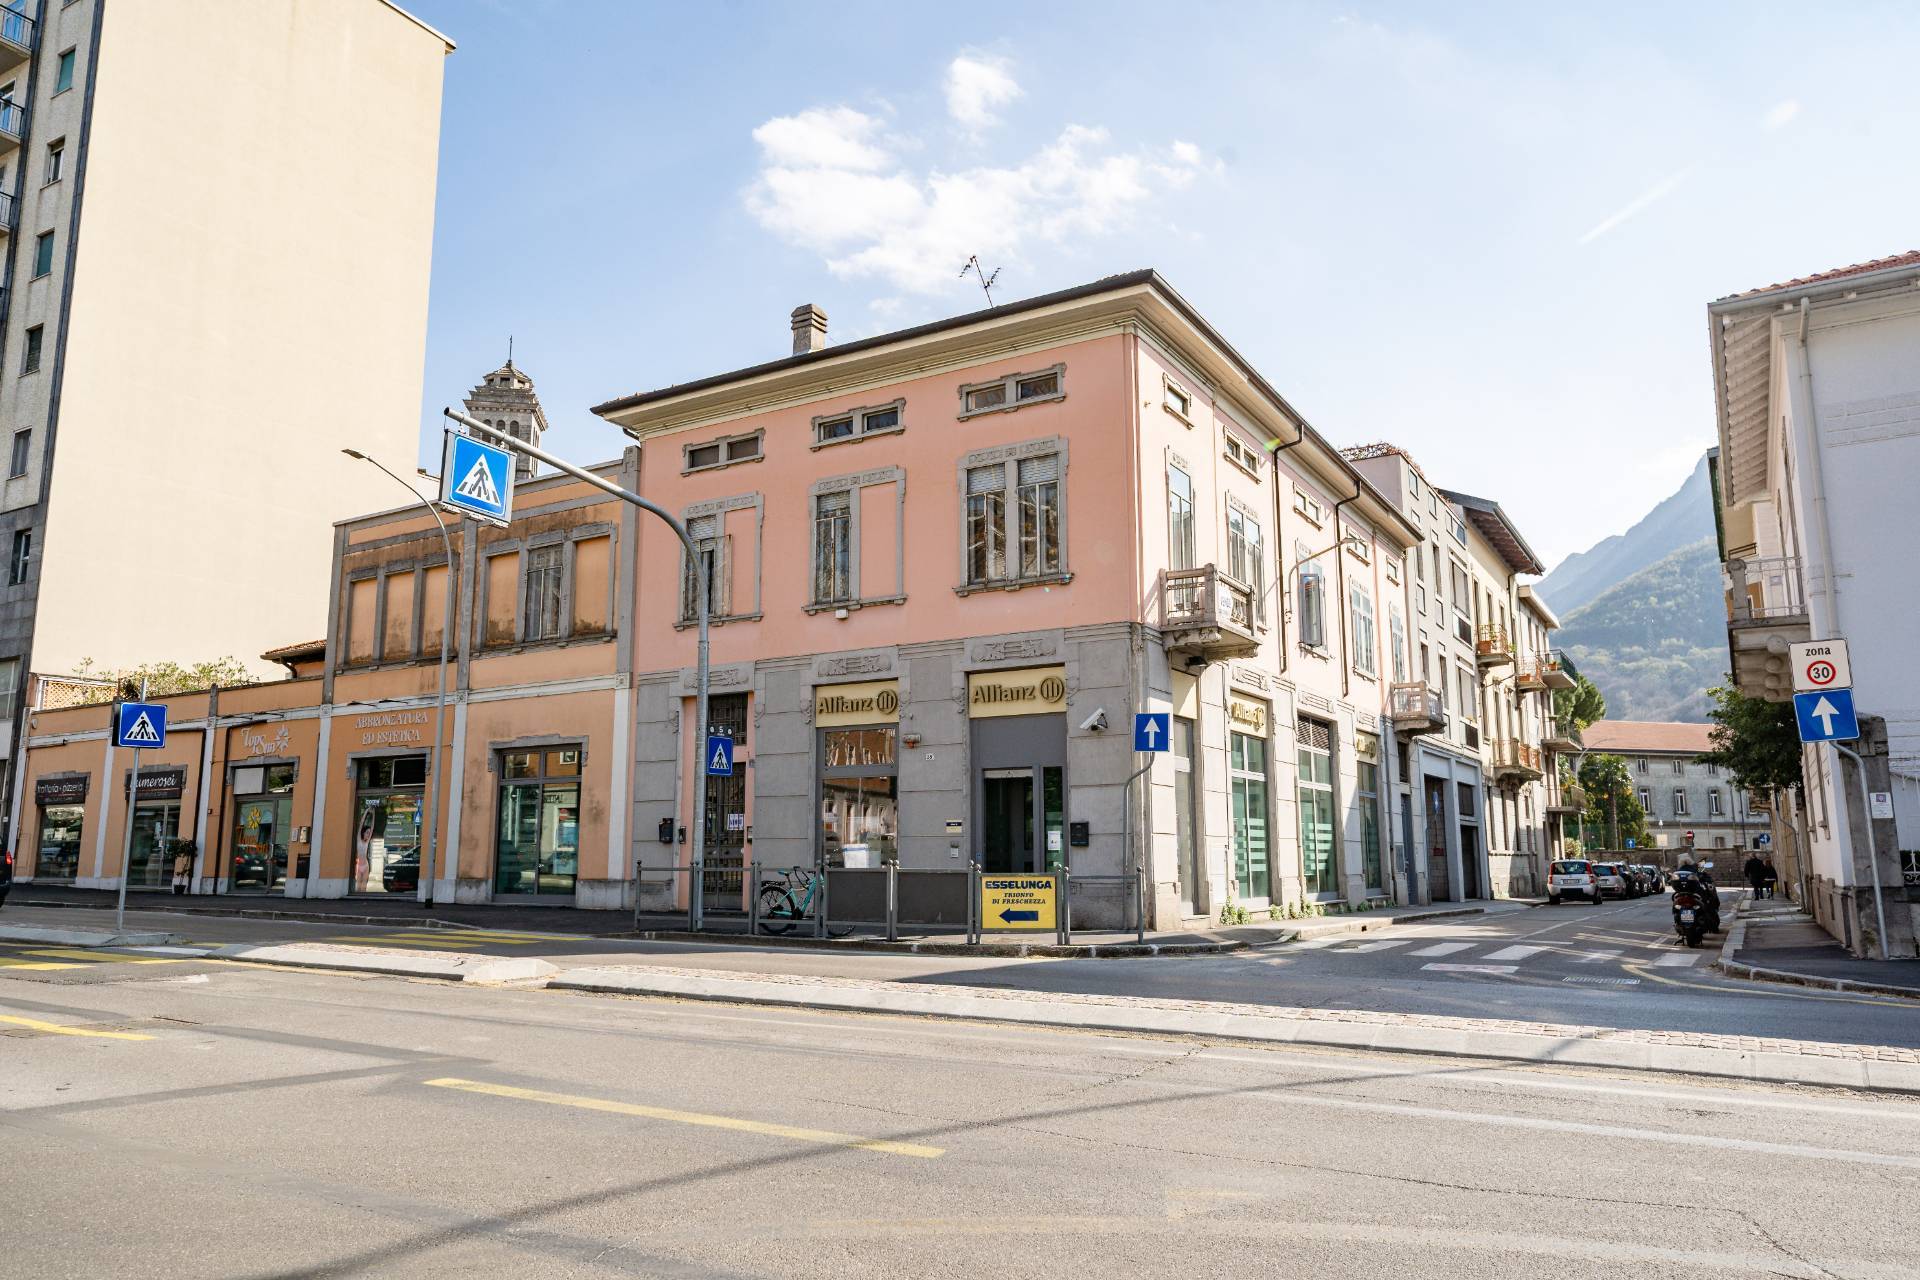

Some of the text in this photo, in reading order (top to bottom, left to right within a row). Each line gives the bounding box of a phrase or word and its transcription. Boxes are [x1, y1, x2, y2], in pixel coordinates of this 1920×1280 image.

[1805, 647, 1831, 657] zona
[1812, 666, 1830, 679] 30
[972, 684, 1036, 703] Allianz
[819, 696, 874, 714] Allianz
[355, 711, 429, 729] ABBRONZATURA
[362, 729, 421, 745] ED ESTETICA
[130, 773, 177, 788] umerosei
[985, 880, 1052, 890] ESSELUNGA
